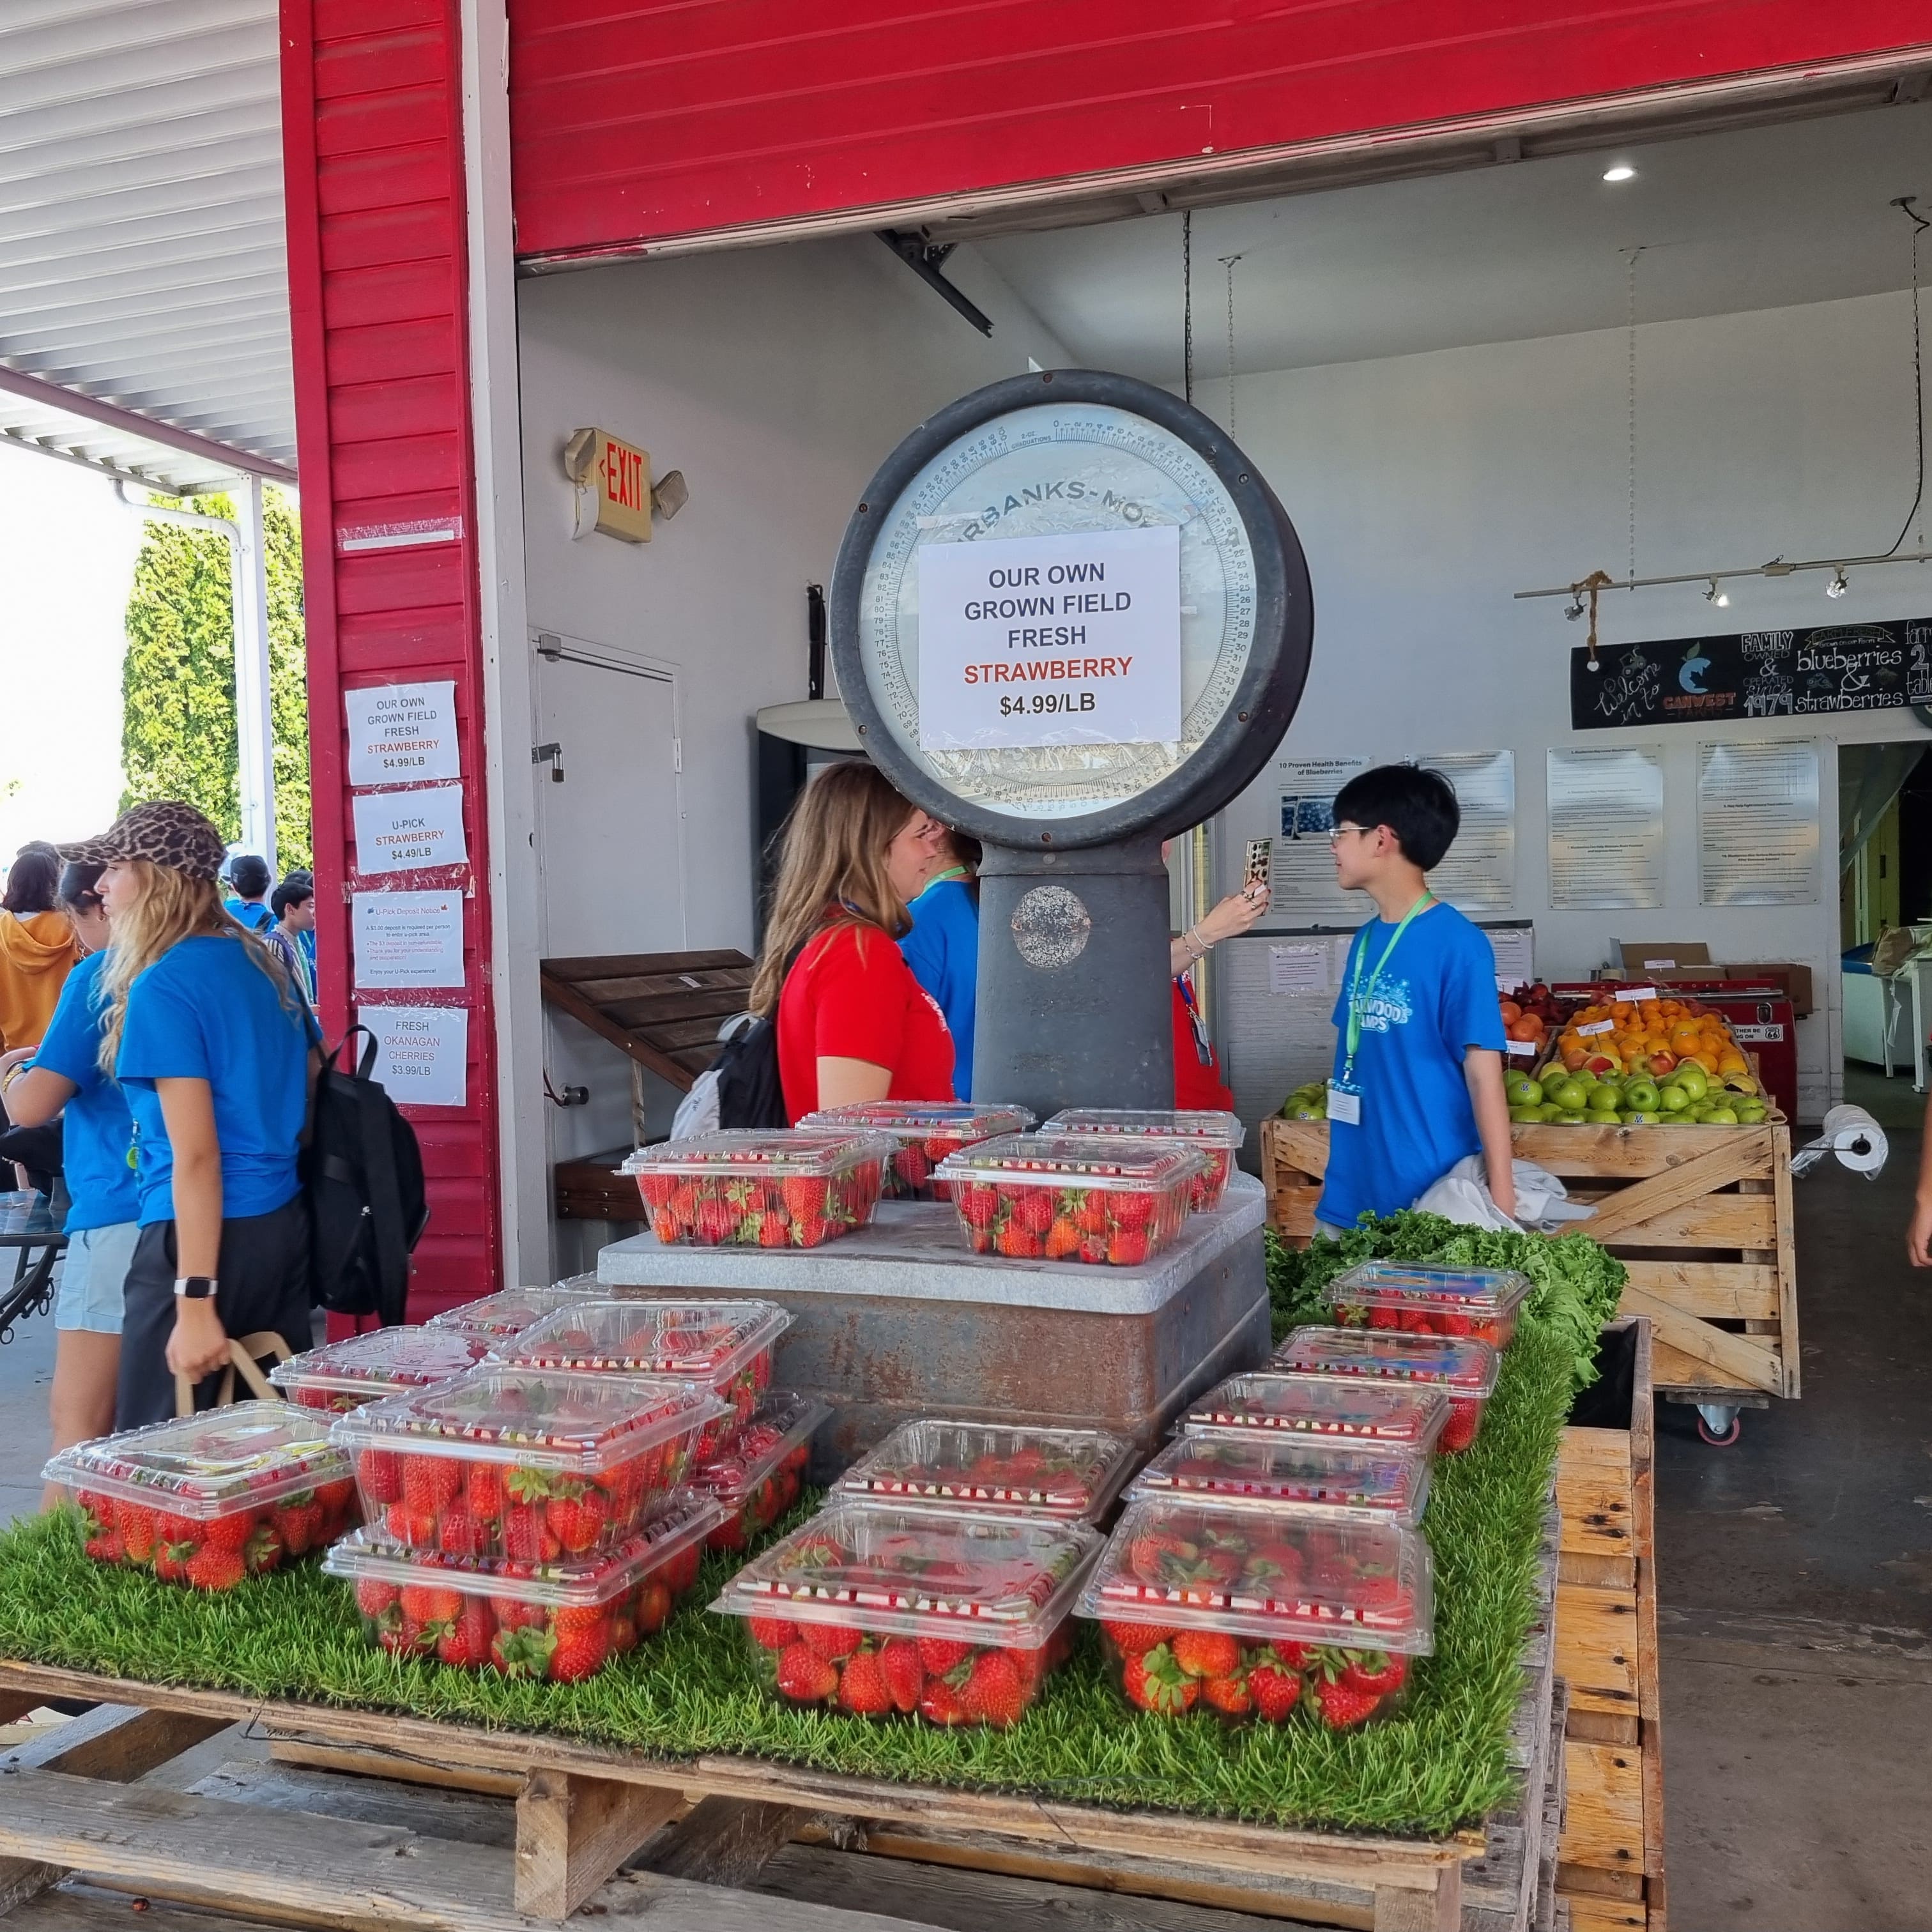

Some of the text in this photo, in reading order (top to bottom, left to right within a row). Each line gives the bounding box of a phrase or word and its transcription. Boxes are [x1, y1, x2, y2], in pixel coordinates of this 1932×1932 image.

[998, 425, 1008, 441] 100
[988, 434, 997, 445] 99
[969, 445, 977, 456] 97
[978, 440, 987, 451] 98
[959, 452, 968, 463] 96
[950, 459, 959, 470] 95
[607, 442, 641, 511] EXIT
[941, 466, 951, 476] 94
[1191, 470, 1200, 479] 14
[926, 482, 935, 492] 92
[1205, 487, 1215, 496] 16
[919, 491, 927, 500] 91
[957, 481, 1150, 542] RBANKS-MO
[1223, 517, 1232, 525] 19
[1234, 549, 1245, 557] 22
[988, 563, 1105, 588] OUR OWN
[965, 592, 1131, 620] GROWN FIELD
[1008, 625, 1086, 648] FRESH
[1742, 631, 1794, 653] FAMILY
[1236, 643, 1246, 652] 30
[1232, 654, 1241, 663] 31
[1744, 649, 1790, 661] OWNED
[1797, 645, 1902, 671] blueberries
[1910, 643, 1929, 670] 2
[964, 657, 1133, 684] STRAWBERRY
[1229, 665, 1239, 675] 32
[1759, 658, 1779, 677] &
[881, 671, 891, 680] 74
[1224, 676, 1235, 686] 33
[1743, 675, 1794, 687] OPERATED
[1841, 661, 1871, 691] &
[884, 682, 894, 691] 73
[1220, 687, 1230, 697] 34
[887, 692, 898, 700] 72
[1663, 693, 1736, 710] CANWEST
[1795, 688, 1904, 712] strawberries
[377, 697, 425, 710] OUR OWN
[892, 702, 901, 710] 71
[1000, 692, 1096, 716] $4.99/LB
[1744, 693, 1793, 716] 1979
[368, 710, 437, 724] GROWN FIELD
[897, 711, 907, 720] 70
[903, 720, 912, 729] 69
[385, 726, 419, 737] FRESH
[909, 728, 918, 738] 68
[1195, 726, 1205, 737] 38
[1187, 735, 1197, 745] 39
[367, 740, 440, 754] STRAWBERRY
[383, 756, 425, 768] $4.99/LB
[392, 818, 425, 829] U-PICK
[376, 831, 445, 845] STRAWBERRY
[392, 847, 431, 860] $4.49/LB
[395, 1021, 429, 1032] FRESH
[384, 1036, 440, 1046] OKANAGAN
[388, 1051, 435, 1061] CHERRIES
[392, 1065, 431, 1076] $3.99/LB
